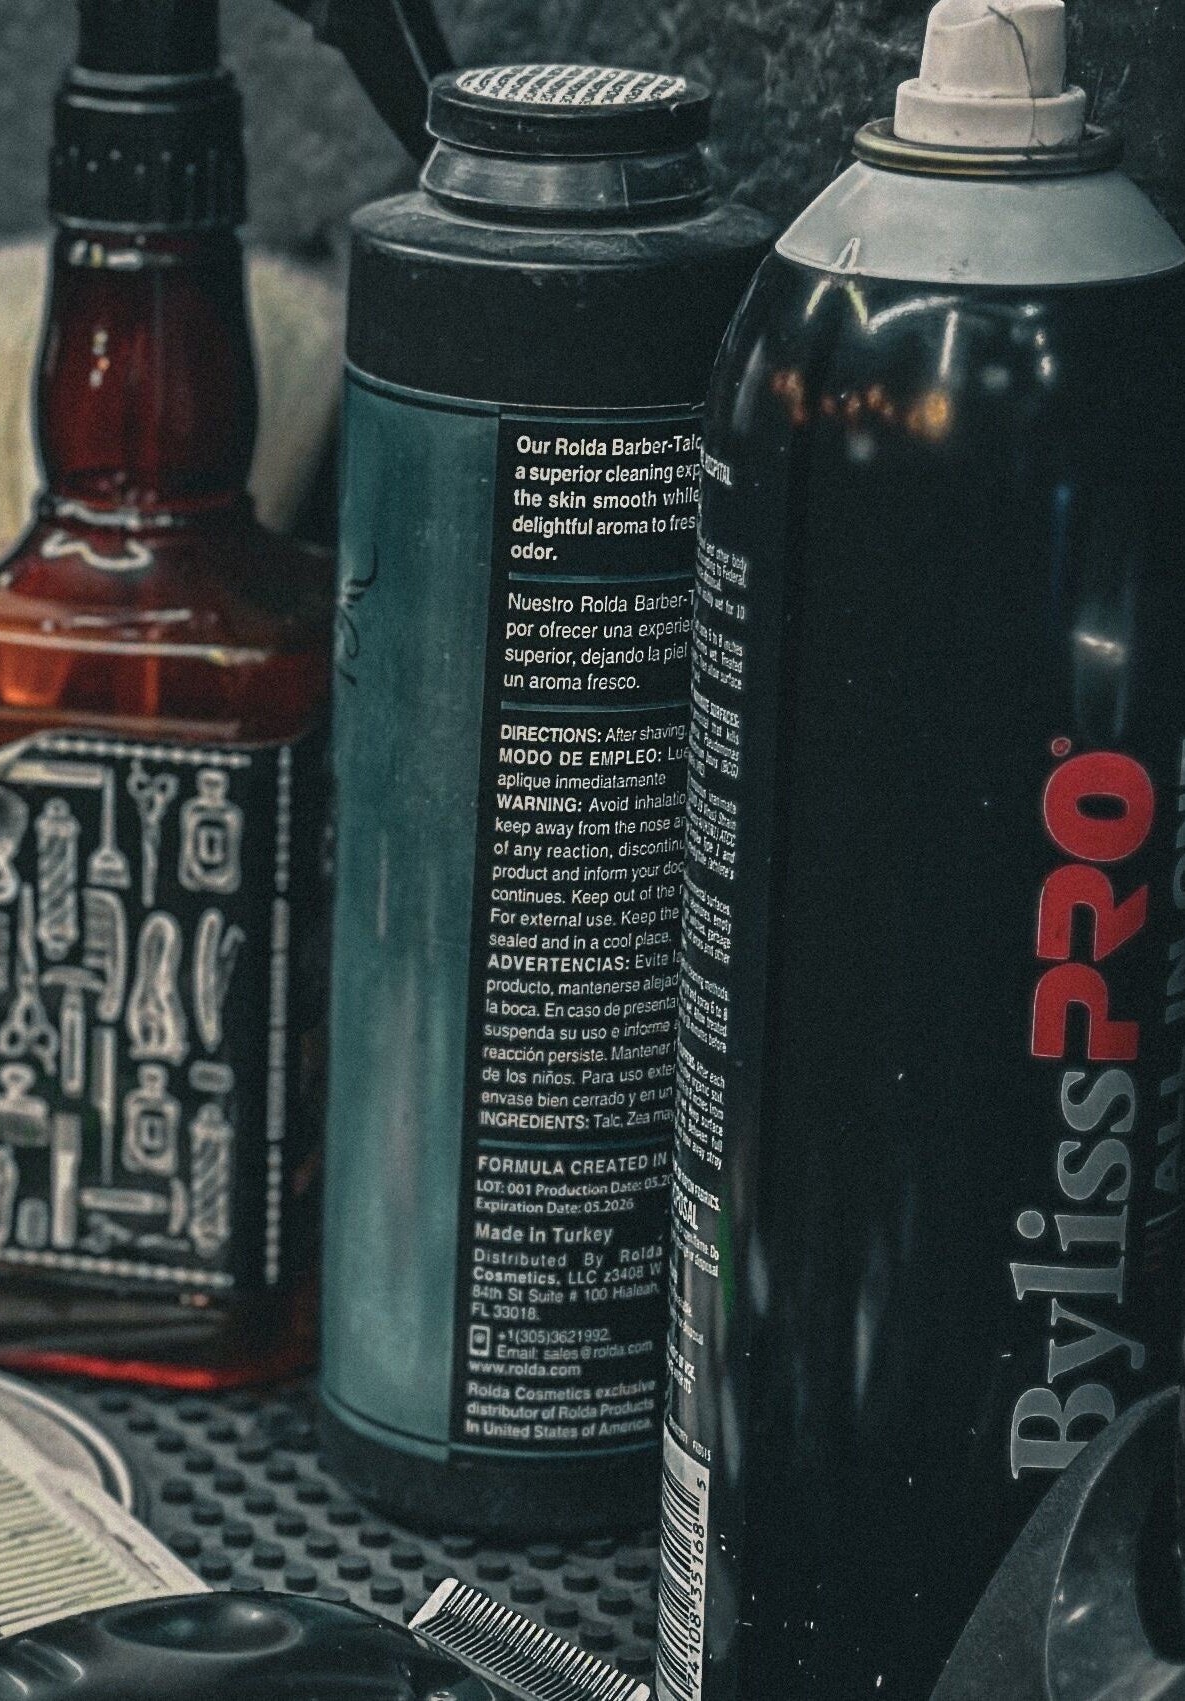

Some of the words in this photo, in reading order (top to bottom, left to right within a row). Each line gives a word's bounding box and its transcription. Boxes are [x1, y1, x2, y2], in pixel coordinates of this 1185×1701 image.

[517, 434, 551, 454] Our
[555, 437, 606, 456] Rolda
[515, 465, 525, 479] a
[529, 464, 602, 485] superior
[605, 463, 673, 483] cleaning
[513, 488, 542, 507] the
[549, 490, 585, 508] skin
[593, 490, 656, 508] smooth
[512, 514, 592, 538] delightful
[596, 520, 647, 534] aroma
[652, 517, 665, 532] to
[511, 542, 557, 560] odor.
[509, 592, 573, 612] Nuestro
[581, 595, 627, 612] Rolda
[506, 622, 534, 639] por
[539, 620, 597, 638] ofrecer
[603, 624, 631, 638] una
[505, 647, 575, 666] superior,
[581, 646, 643, 668] dejando
[648, 645, 659, 661] la
[663, 641, 687, 664] piel
[503, 674, 523, 687] un
[529, 675, 581, 690] aroma
[587, 673, 639, 689] fresco.
[501, 724, 601, 742] DIRECTIONS:
[605, 727, 636, 742] After
[499, 747, 552, 765] MODO
[559, 750, 582, 765] DE
[590, 748, 661, 765] EMPLEO:
[497, 772, 550, 791] aplique
[555, 772, 665, 789] inmediatamente
[497, 793, 581, 812] WARNING:
[588, 796, 628, 812] Avoid
[495, 816, 530, 836] keep
[535, 822, 573, 839] away
[579, 820, 609, 835] from
[615, 820, 635, 834] the
[640, 818, 670, 832] nose
[494, 840, 508, 854] of
[514, 844, 541, 860] any
[492, 865, 547, 880] product
[552, 866, 579, 881] and
[584, 866, 627, 880] inform
[632, 865, 658, 881] your
[491, 887, 565, 903] continues.
[572, 889, 608, 906] Keep
[614, 888, 634, 902] out
[640, 885, 651, 899] of
[657, 885, 674, 898] the
[490, 907, 515, 924] For
[520, 912, 581, 926] external
[586, 914, 615, 926] use.
[622, 910, 655, 927] Keep
[661, 906, 678, 920] the
[489, 933, 537, 948] sealed
[541, 935, 569, 949] and
[573, 935, 585, 949] in
[590, 937, 598, 949] a
[603, 933, 631, 948] cool
[635, 931, 671, 949] place.
[488, 953, 629, 972] ADVERTENCIAS:
[636, 953, 668, 968] Evite
[486, 978, 553, 995] producto,
[558, 980, 639, 995] mantenerse
[486, 998, 497, 1013] la
[502, 999, 539, 1016] boca.
[545, 1002, 563, 1017] En
[567, 1005, 600, 1017] caso
[604, 1002, 620, 1016] de
[484, 1024, 554, 1041] suspenda
[560, 1028, 576, 1040] su
[582, 1027, 606, 1039] uso
[483, 1046, 543, 1061] reacción
[547, 1048, 606, 1065] persiste.
[611, 1042, 670, 1060] Mantener
[482, 1066, 499, 1081] de
[506, 1067, 526, 1083] los
[533, 1070, 574, 1084] niños.
[582, 1070, 613, 1084] Para
[620, 1069, 643, 1082] uso
[481, 1091, 533, 1106] envase
[538, 1092, 568, 1107] bien
[573, 1091, 624, 1107] cerrado
[629, 1092, 636, 1107] y
[640, 1089, 654, 1101] en
[659, 1086, 672, 1099] un
[480, 1110, 589, 1129] INGREDIENTS:
[478, 1155, 563, 1175] FORMULA
[571, 1154, 647, 1175] CREATED
[653, 1151, 666, 1166] IN
[507, 1182, 530, 1195] 001
[535, 1183, 607, 1196] Production
[611, 1181, 641, 1193] Date:
[476, 1196, 543, 1213] Expiration
[547, 1201, 580, 1213] Date:
[584, 1197, 633, 1213] 05.2026
[475, 1222, 523, 1241] Made
[529, 1226, 545, 1242] in
[552, 1226, 612, 1244] Turkey
[474, 1247, 566, 1267] Distributed
[584, 1252, 602, 1268] By
[620, 1245, 662, 1262] Rolda
[568, 1269, 596, 1284] LLC
[508, 1287, 522, 1301] St
[529, 1288, 563, 1303] Suite
[585, 1287, 607, 1301] 100
[471, 1301, 489, 1317] FL
[469, 1360, 580, 1376] www.rolda.com
[468, 1381, 510, 1399] Rolda
[515, 1386, 591, 1400] Cosmetics
[467, 1401, 539, 1419] distributor
[541, 1405, 555, 1419] of
[558, 1405, 597, 1419] Rolda
[600, 1398, 654, 1416] Products
[483, 1421, 530, 1438] United
[534, 1424, 577, 1438] States
[581, 1423, 595, 1436] of
[696, 1479, 707, 1491] 5
